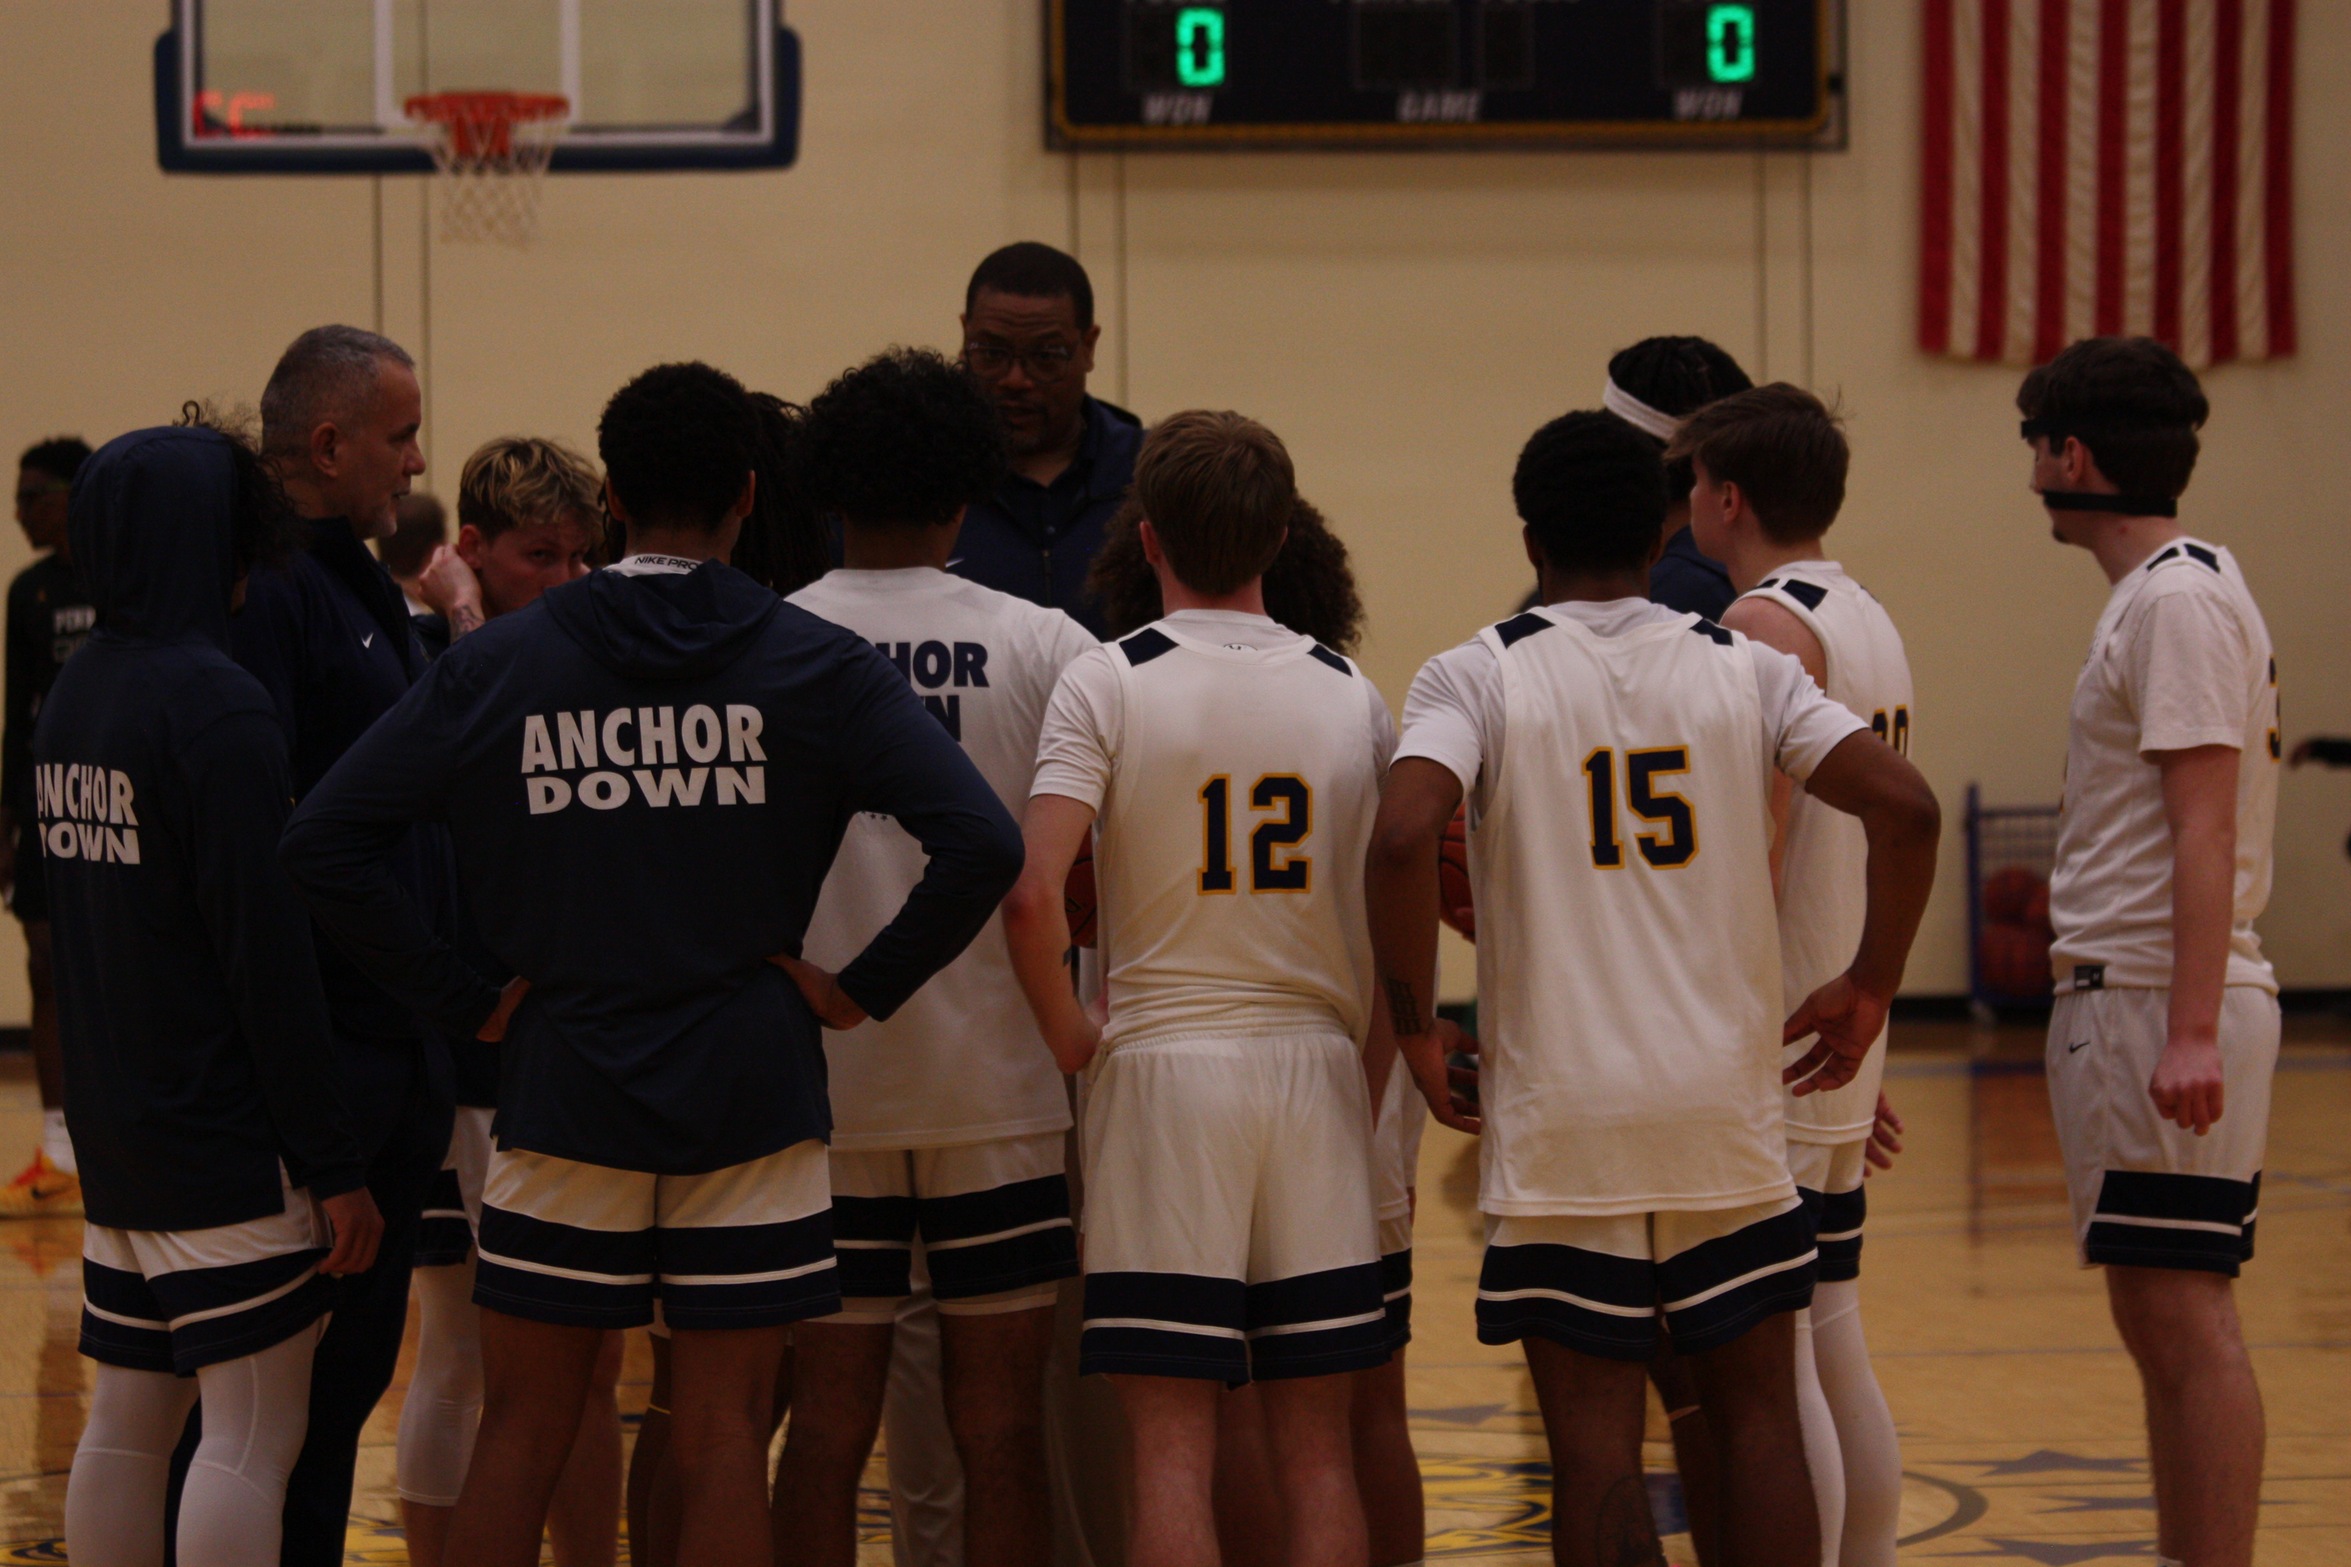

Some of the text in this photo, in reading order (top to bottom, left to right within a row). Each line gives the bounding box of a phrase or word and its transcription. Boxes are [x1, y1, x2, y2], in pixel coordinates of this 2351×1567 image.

[1175, 6, 1226, 87] 0
[1705, 2, 1756, 84] 0
[634, 556, 699, 570] NIKE PRO
[521, 703, 768, 774] ANCHOR
[36, 763, 139, 826] ANCHOR
[526, 766, 766, 815] DOWN
[1581, 745, 1699, 870] 15
[1197, 773, 1312, 895] 12
